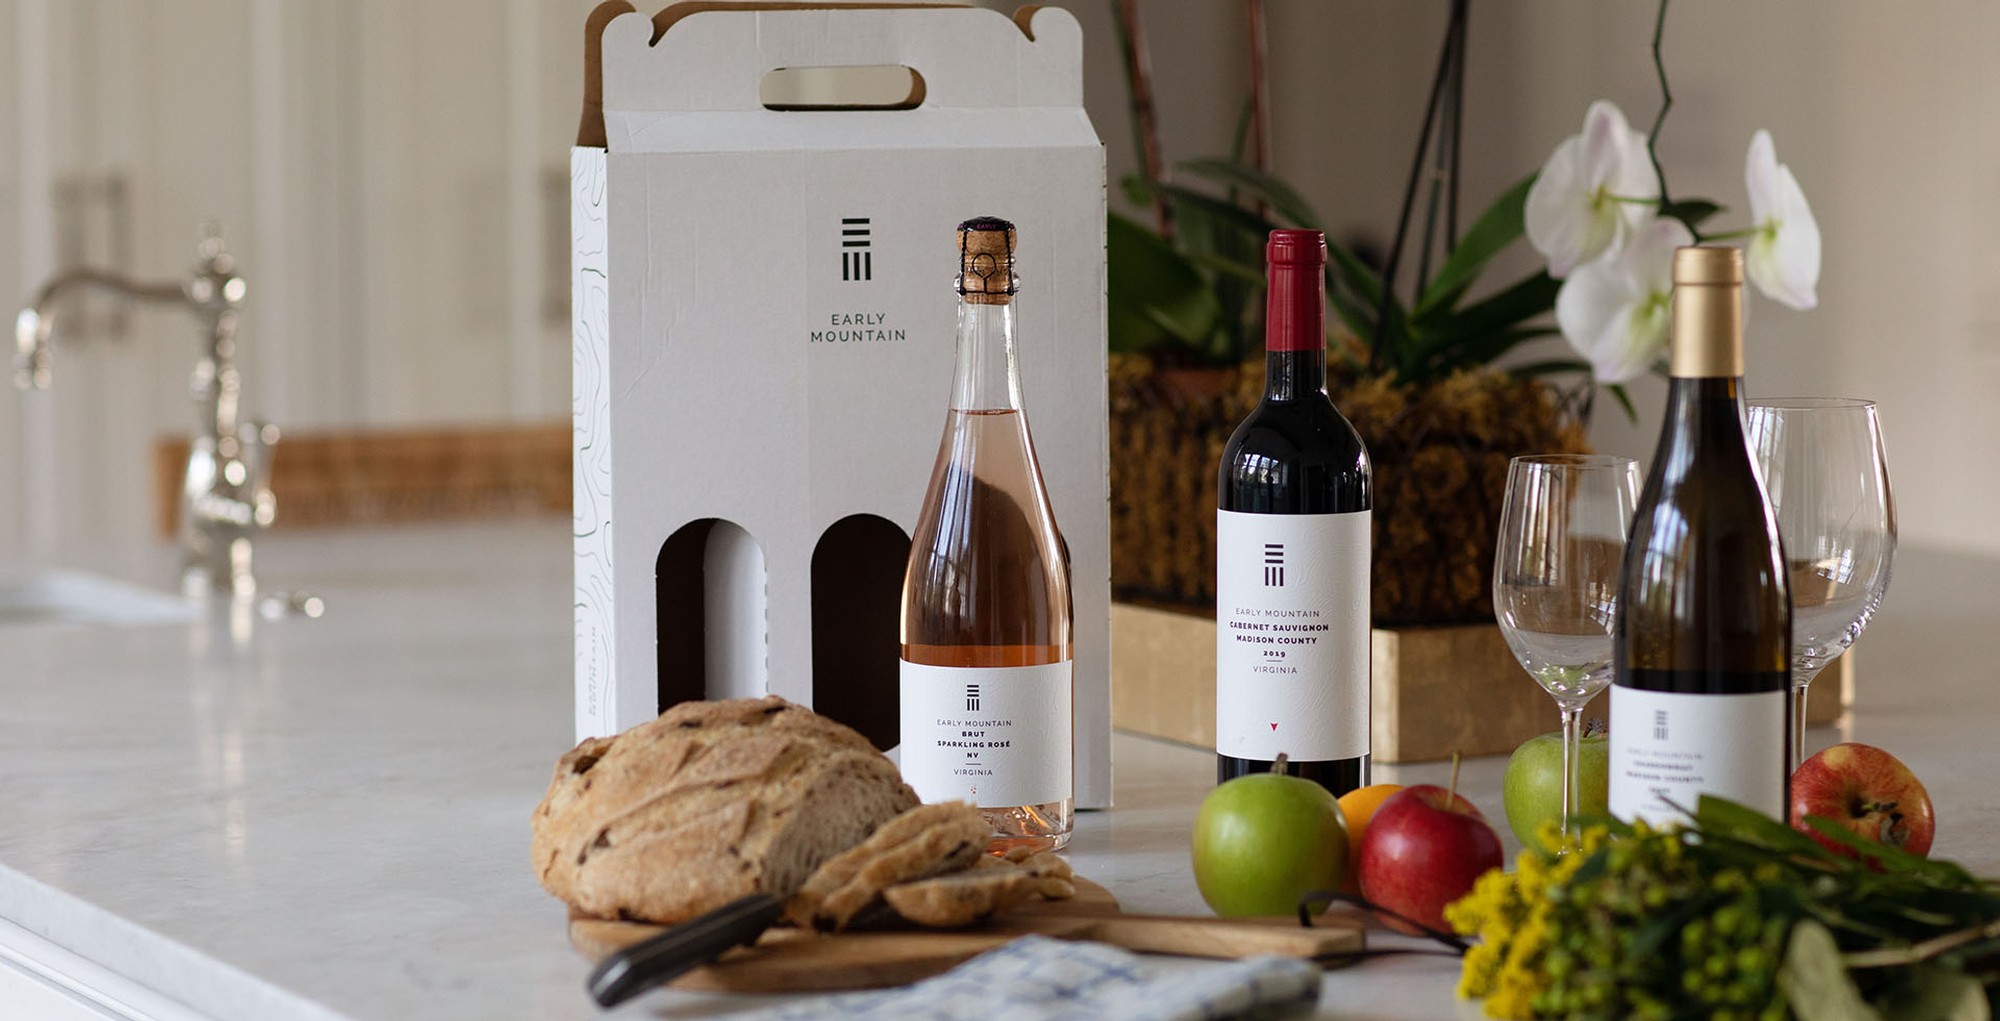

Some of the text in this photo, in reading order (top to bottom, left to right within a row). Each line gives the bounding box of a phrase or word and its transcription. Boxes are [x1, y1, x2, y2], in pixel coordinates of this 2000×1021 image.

[831, 313, 886, 326] EARLY
[810, 329, 906, 342] MOUNTAIN
[1235, 607, 1320, 618] EARLY MOUNTAIN
[1229, 621, 1329, 632] CABERNET SAUVIGNON
[1236, 634, 1317, 645] MADISON COUNTY
[1263, 650, 1286, 658] 2019
[1252, 665, 1298, 674] VIRGINIA
[936, 719, 1012, 728] EARLY MOUNTAIN
[937, 740, 1011, 748] SPARKLING ROSÉ
